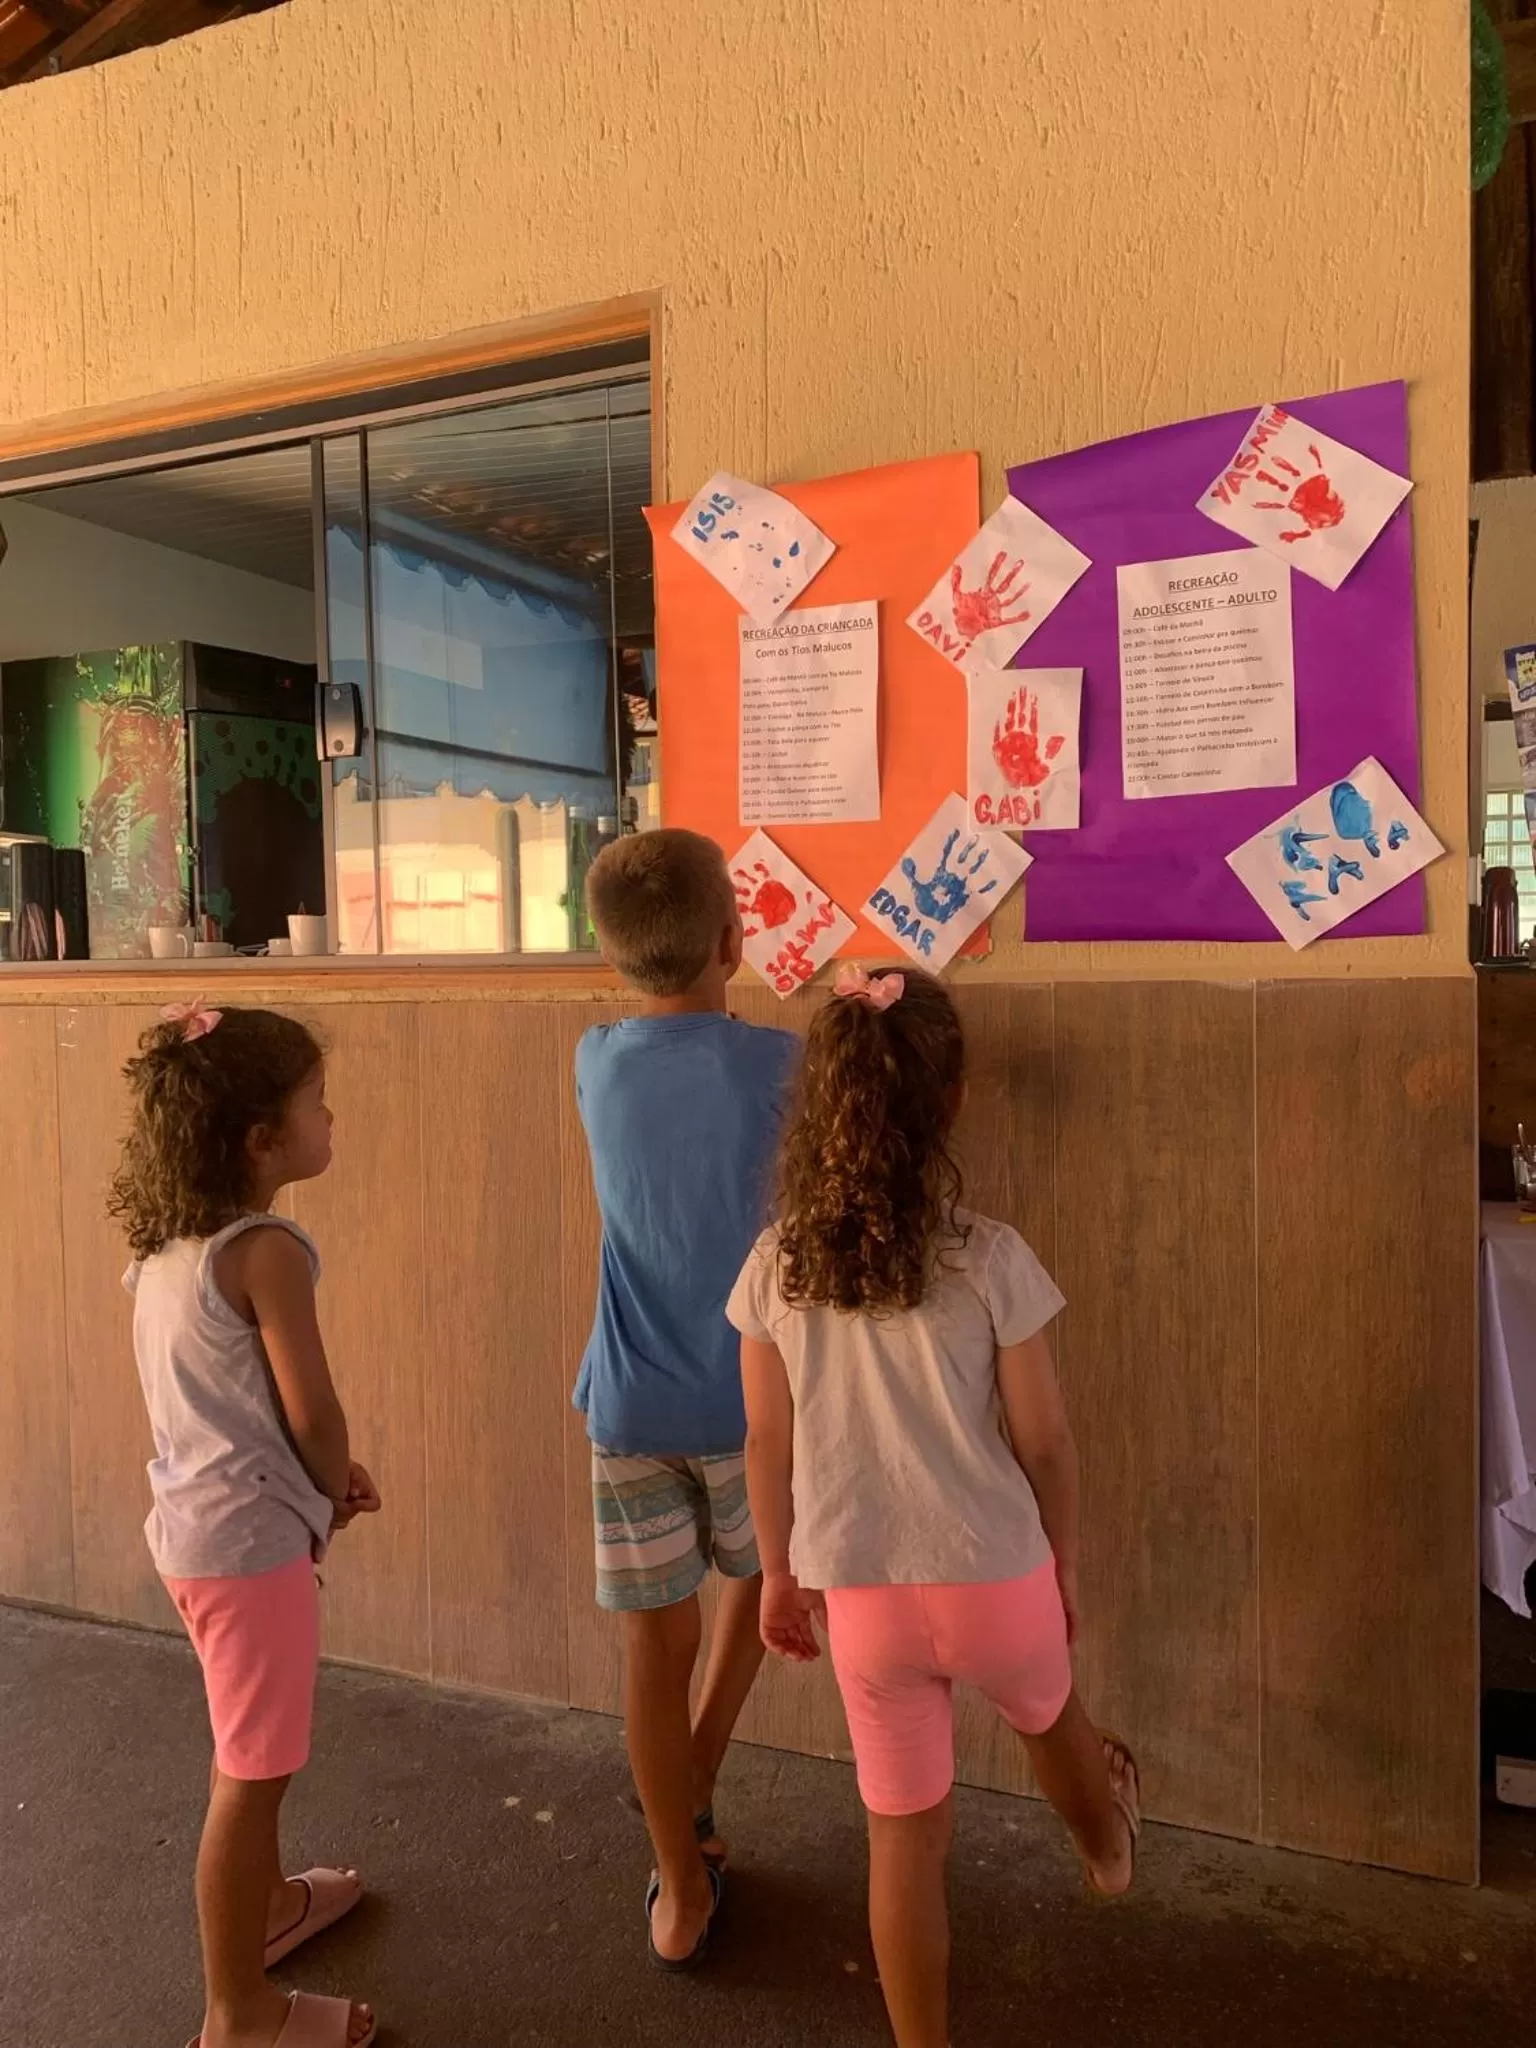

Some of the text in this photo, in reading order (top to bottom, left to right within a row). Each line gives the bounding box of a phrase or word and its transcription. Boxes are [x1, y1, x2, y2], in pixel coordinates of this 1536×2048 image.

[691, 493, 735, 543] ISIS
[1168, 571, 1239, 591] RECREAÇÃO
[1133, 597, 1214, 618] ADOLESCENTE
[1227, 589, 1277, 606] ADULTO
[742, 617, 873, 640] RECREAÇÃO DA CRIANÇADA
[755, 642, 852, 659] Com os Tios Malucos
[869, 888, 936, 956] EDGAR
